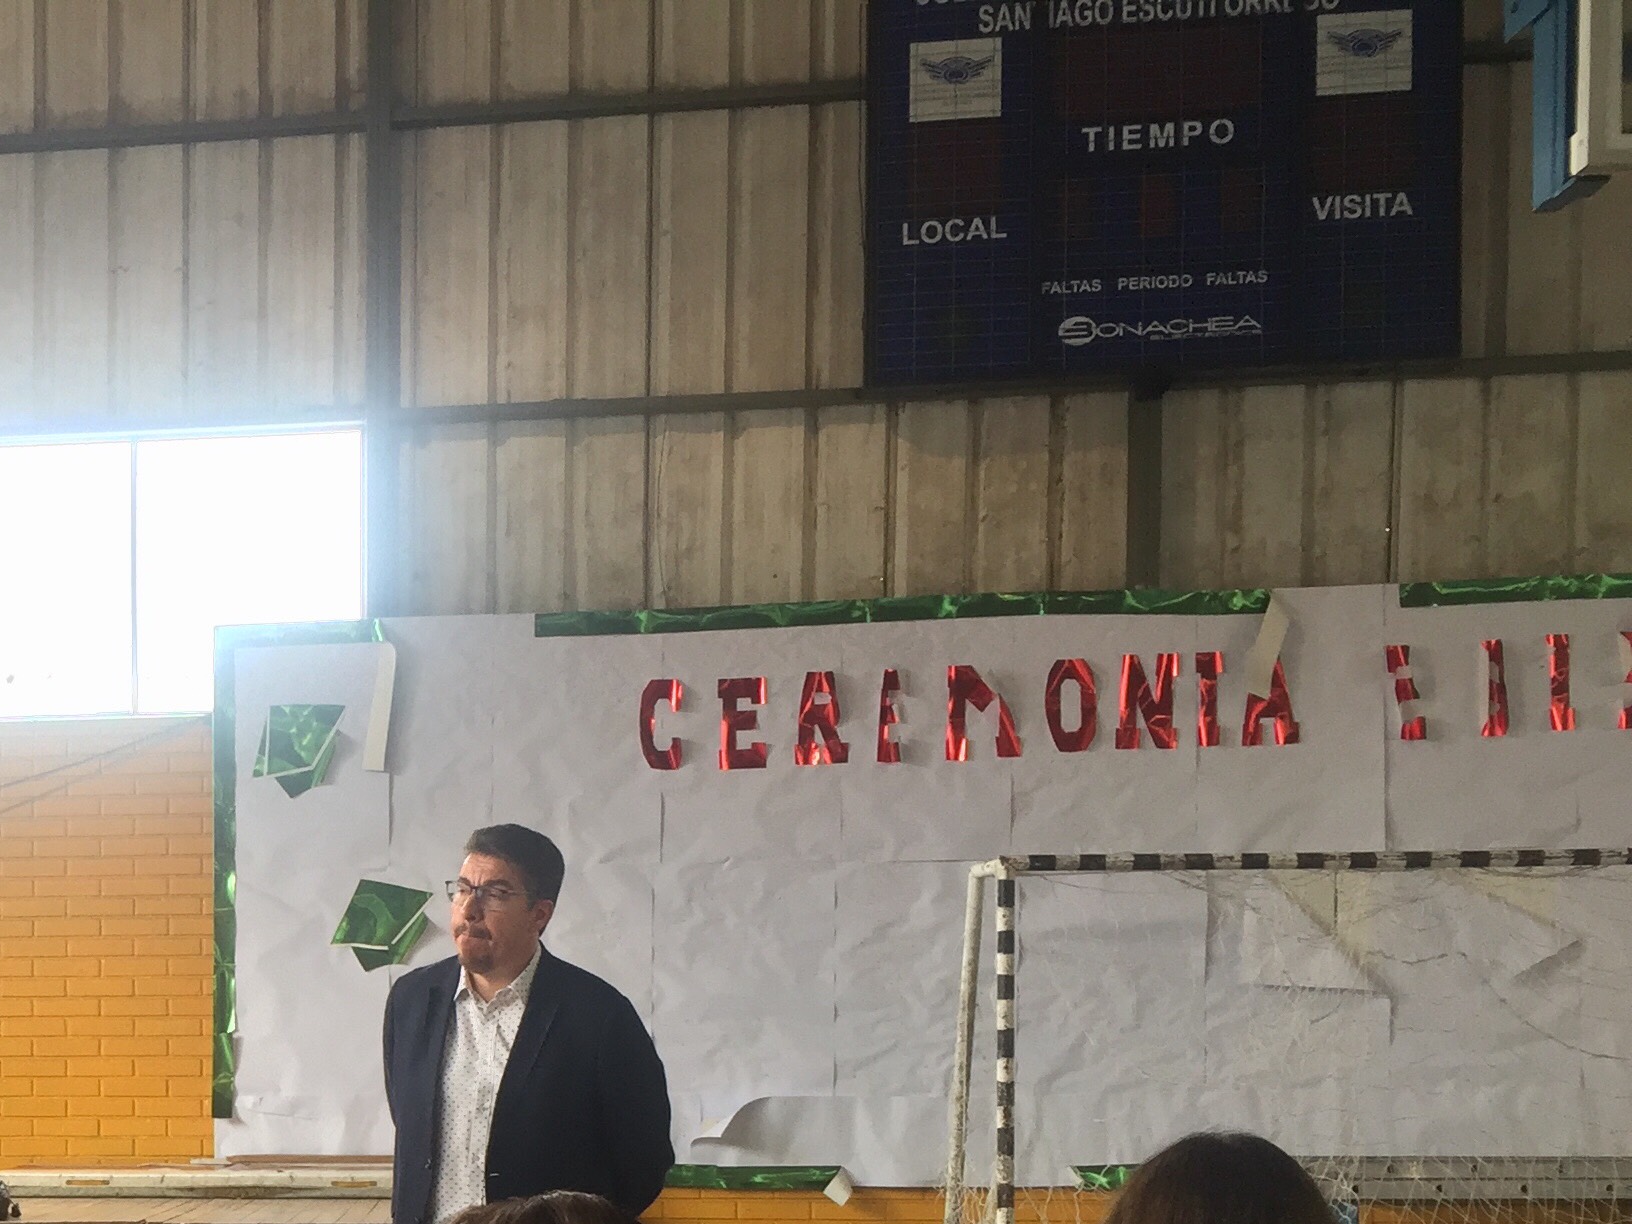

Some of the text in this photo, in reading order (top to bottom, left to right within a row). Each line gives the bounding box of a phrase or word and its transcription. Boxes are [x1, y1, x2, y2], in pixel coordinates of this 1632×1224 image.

[978, 0, 1114, 33] SANIAGO
[1081, 118, 1235, 152] TIEMPO
[1313, 192, 1414, 221] VISITA
[902, 215, 1008, 246] LOCAL
[1041, 270, 1269, 295] FALTAS PERIODO FALTAS
